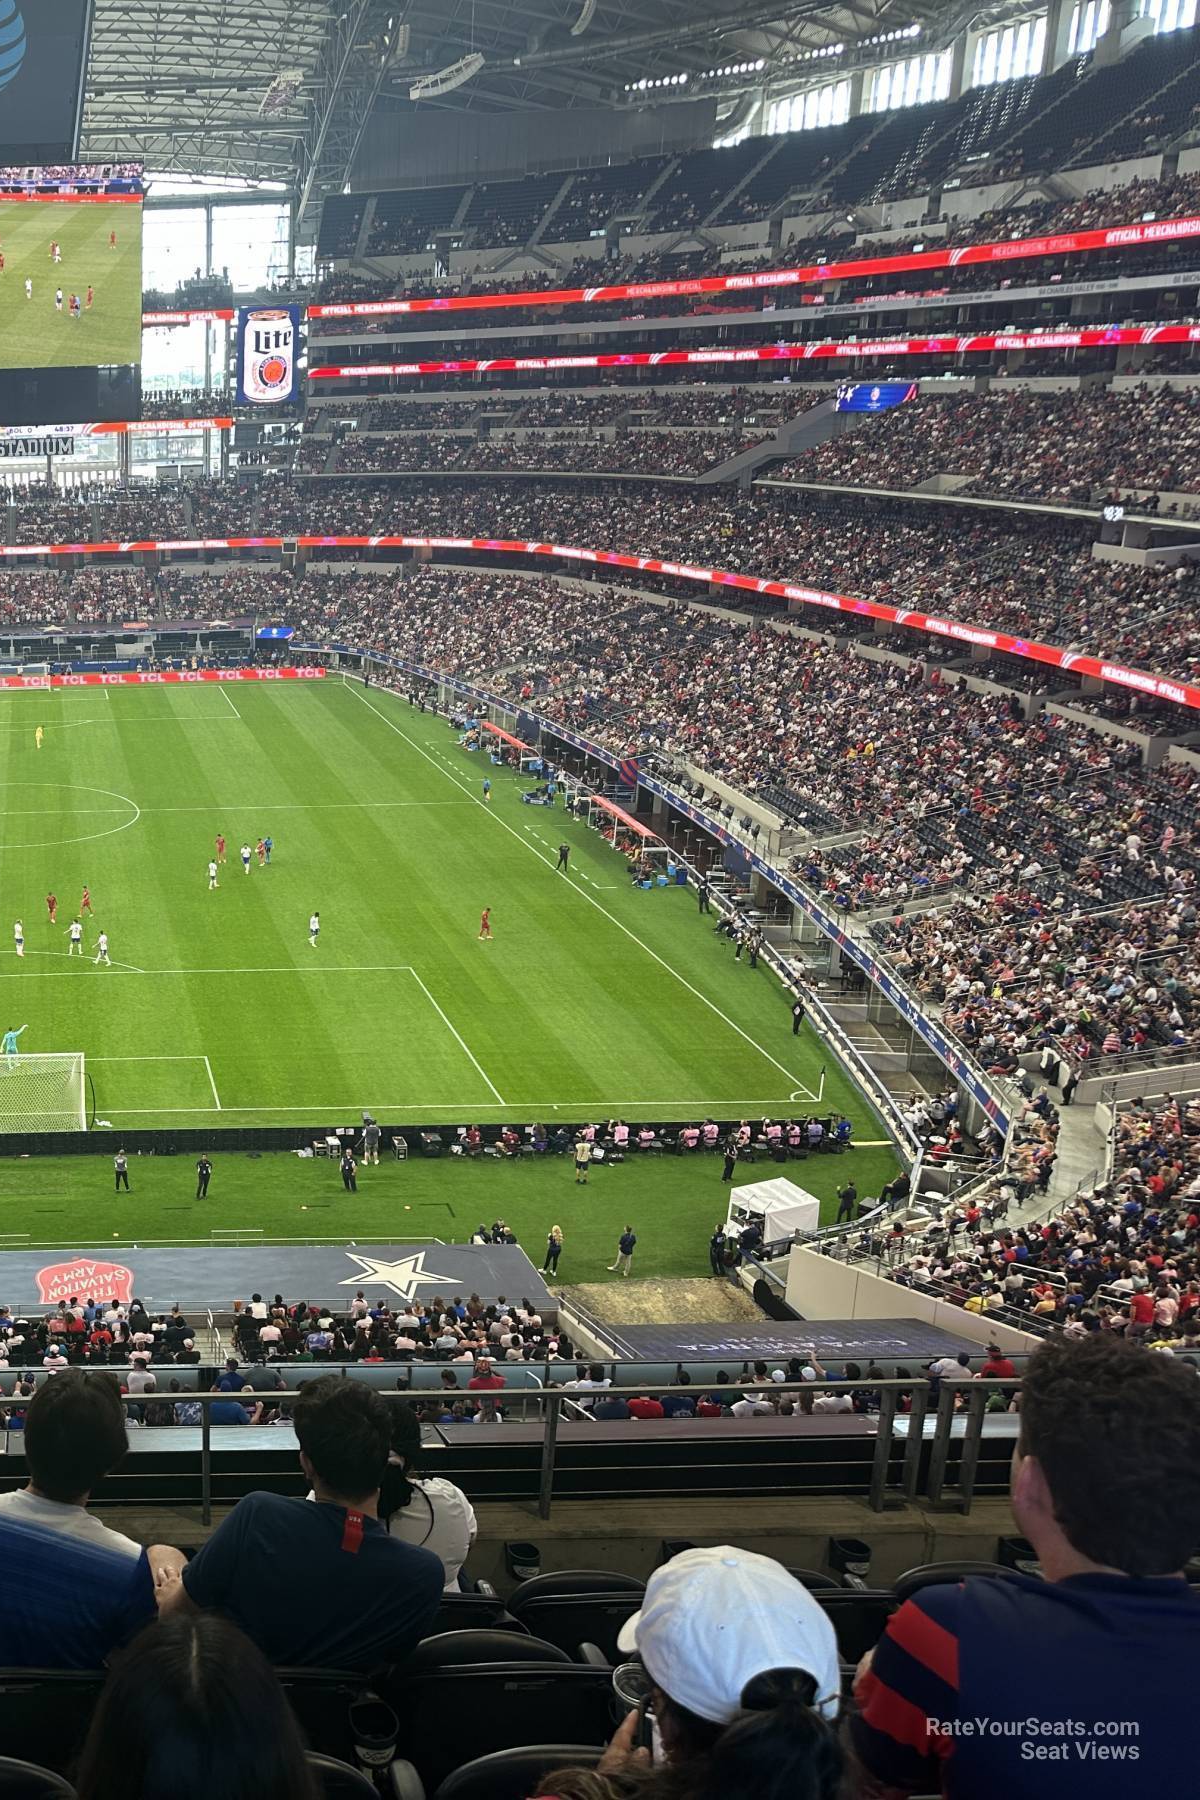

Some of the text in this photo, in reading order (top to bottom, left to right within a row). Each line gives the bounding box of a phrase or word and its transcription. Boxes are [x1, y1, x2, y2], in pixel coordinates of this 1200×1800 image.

[1106, 227, 1143, 244] OFFICIAL
[725, 272, 799, 288] OFFICIAL MERCHANDISING
[321, 303, 410, 314] OFFICIAL MERCHANDISING
[253, 330, 292, 354] Lite
[994, 334, 1081, 348] OFFICIAL MERCHANDISING
[836, 343, 909, 355] OFFICIAL MERCHANDISING
[515, 357, 598, 368] OFFICIAL MERCHANDISING
[340, 364, 420, 375] MERCHANDISING OFICIAL
[127, 420, 216, 430] MERCHANDISING OFICIAL
[925, 619, 996, 645] OFFICIAL MERCHANDISING
[138, 673, 166, 682] TCL
[177, 672, 205, 681] TCL
[216, 671, 244, 680] TCL
[256, 669, 283, 679] TCL
[295, 668, 322, 678] TCL
[21, 676, 48, 686] TCL
[60, 675, 87, 685] TCL
[99, 674, 127, 684] TCL
[1101, 665, 1186, 703] MERCHANDISING OFICIAL
[49, 1263, 97, 1286] ARMY
[48, 1268, 126, 1301] SALVATION
[80, 1285, 116, 1301] THE
[348, 1515, 361, 1523] USA
